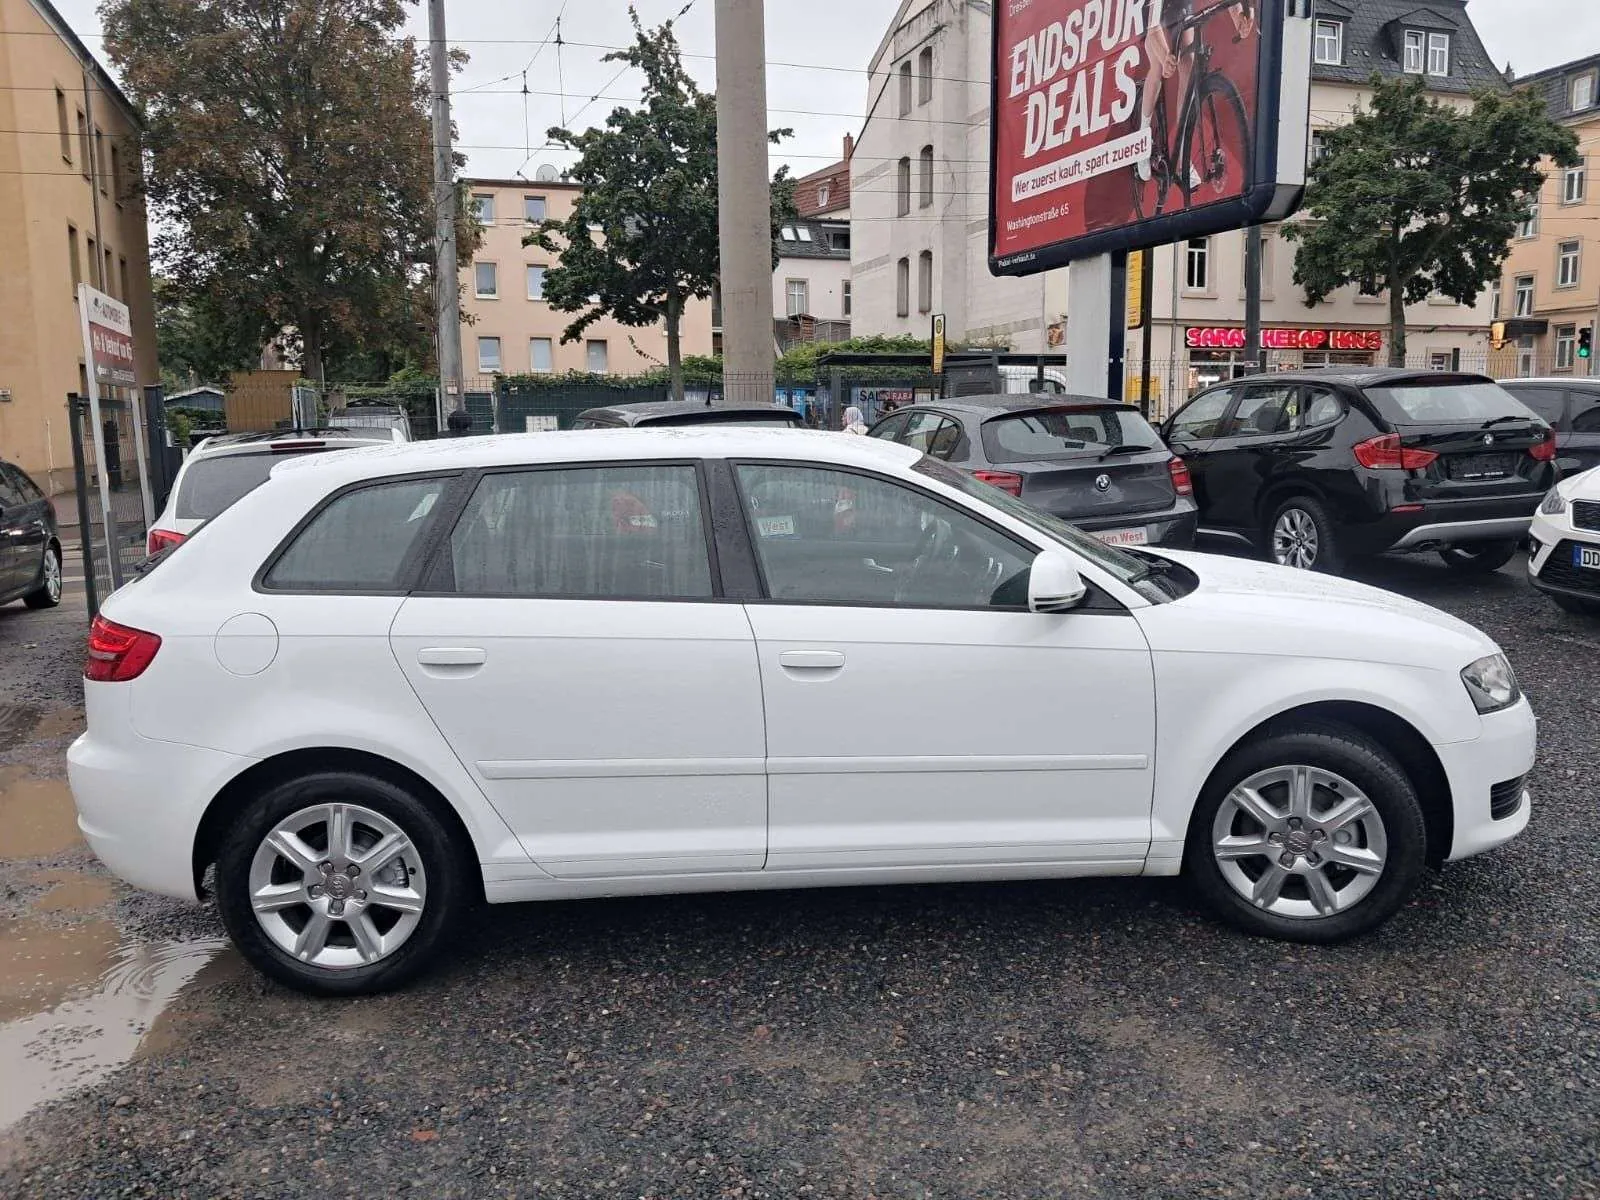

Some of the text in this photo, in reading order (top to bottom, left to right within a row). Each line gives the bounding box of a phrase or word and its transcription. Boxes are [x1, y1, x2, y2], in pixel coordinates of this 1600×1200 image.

[1022, 44, 1141, 159] DEALS
[1014, 135, 1148, 196] Wer zuerst kauft, spart zuerst!
[1060, 202, 1070, 217] 65
[1120, 531, 1144, 542] West
